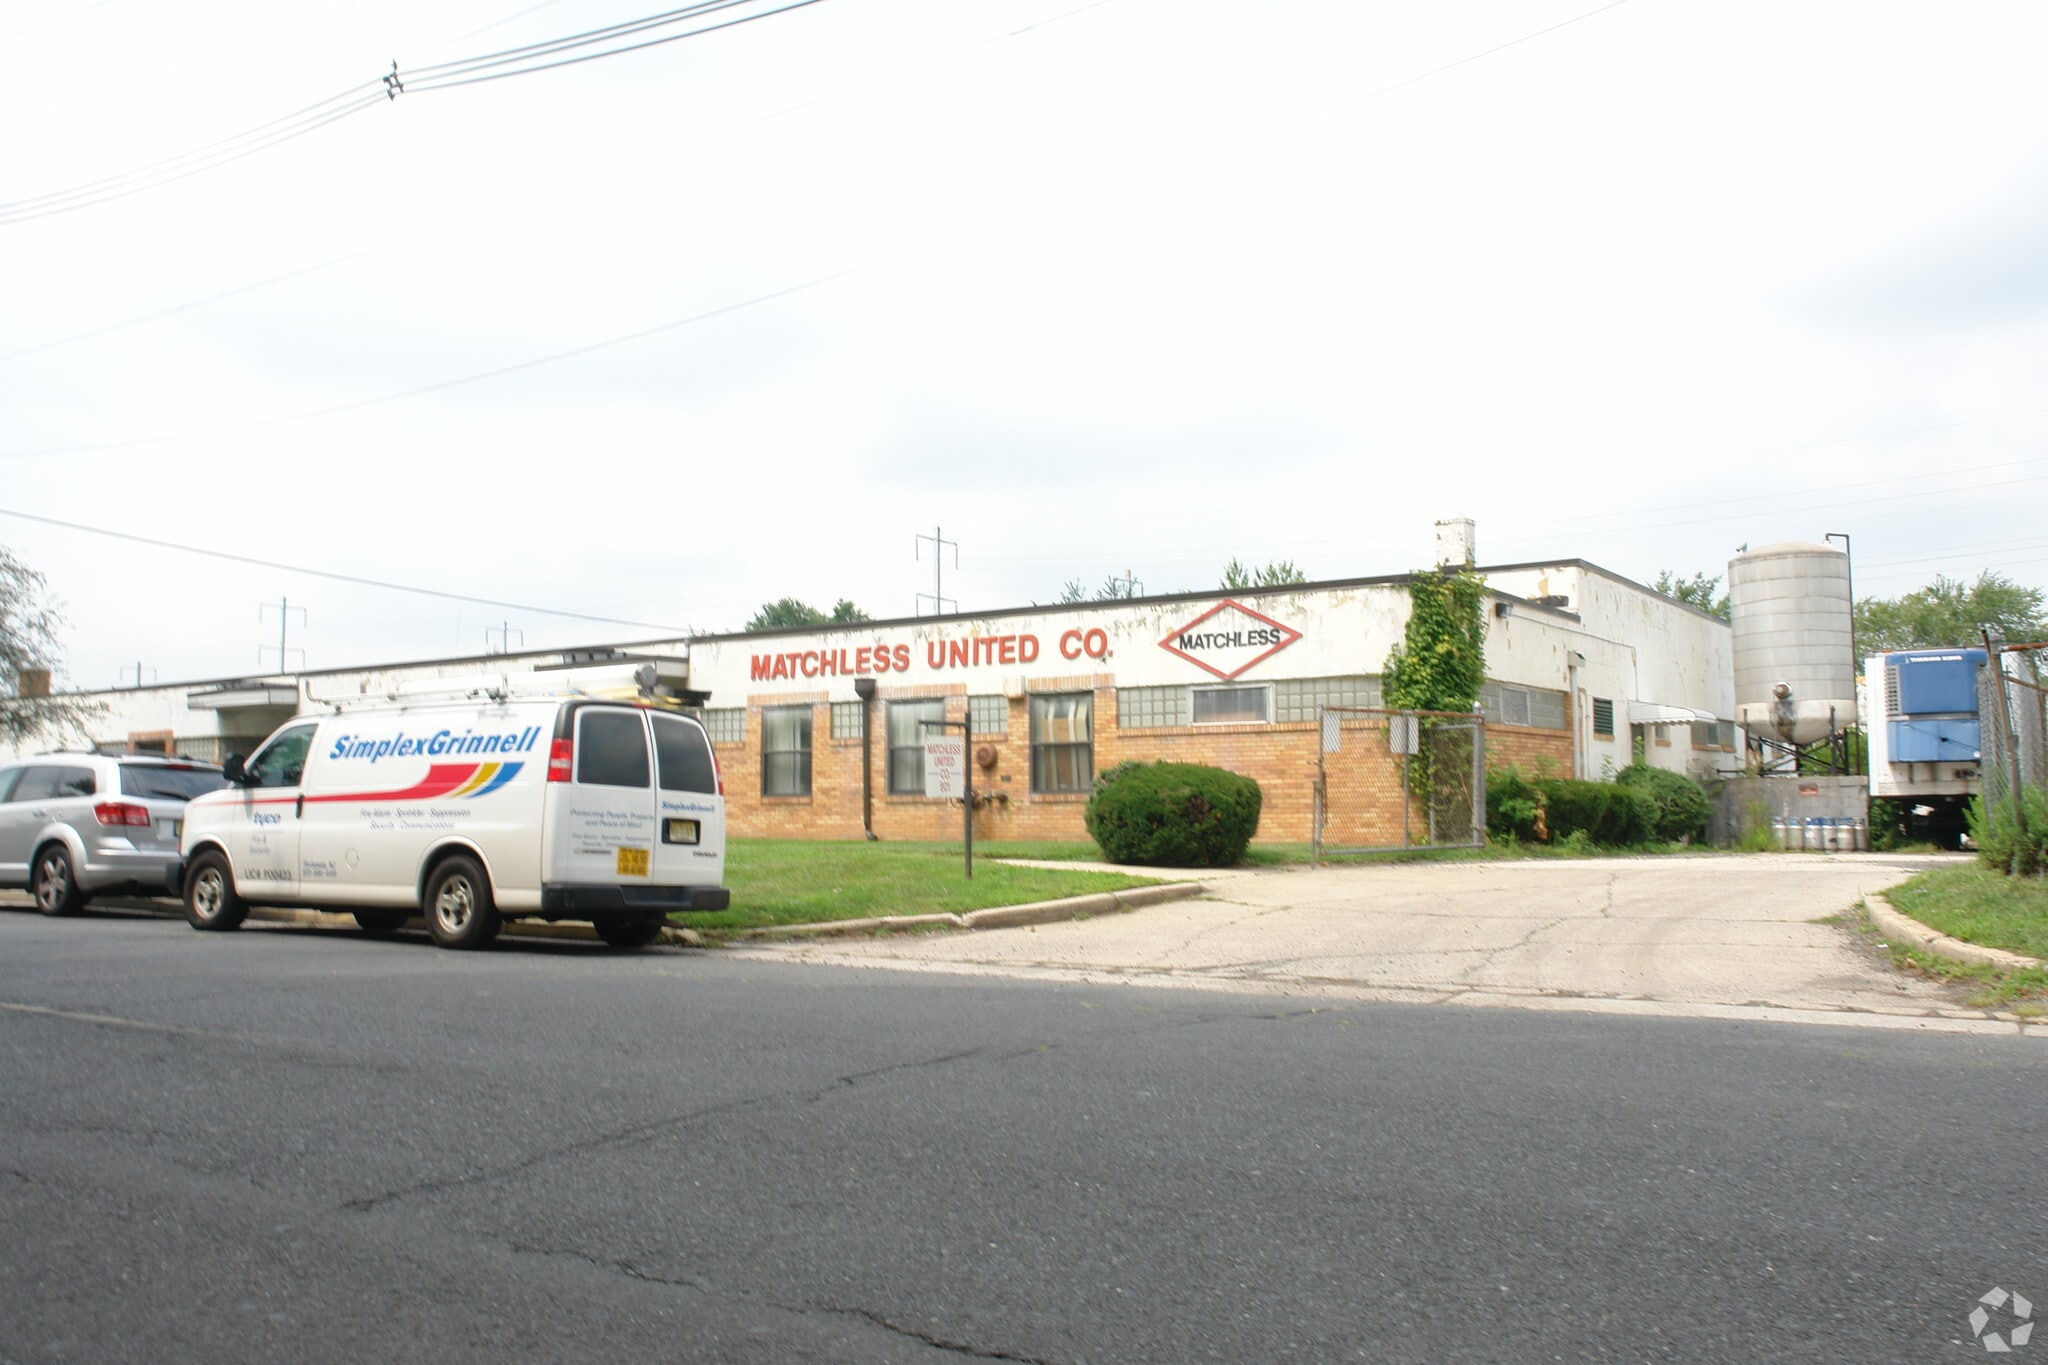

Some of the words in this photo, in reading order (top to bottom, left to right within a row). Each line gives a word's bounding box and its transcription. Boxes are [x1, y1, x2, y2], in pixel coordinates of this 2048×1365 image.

[1179, 627, 1281, 650] MATCHLESS
[750, 644, 910, 681] MATCHLESS
[927, 634, 1039, 670] UNITED
[1059, 627, 1114, 660] CO.
[1910, 655, 1941, 663] THERMO
[329, 725, 542, 764] SimplexGrinnell
[927, 743, 961, 755] MATCHLESS
[934, 756, 955, 768] UNITED
[253, 811, 282, 827] tyco
